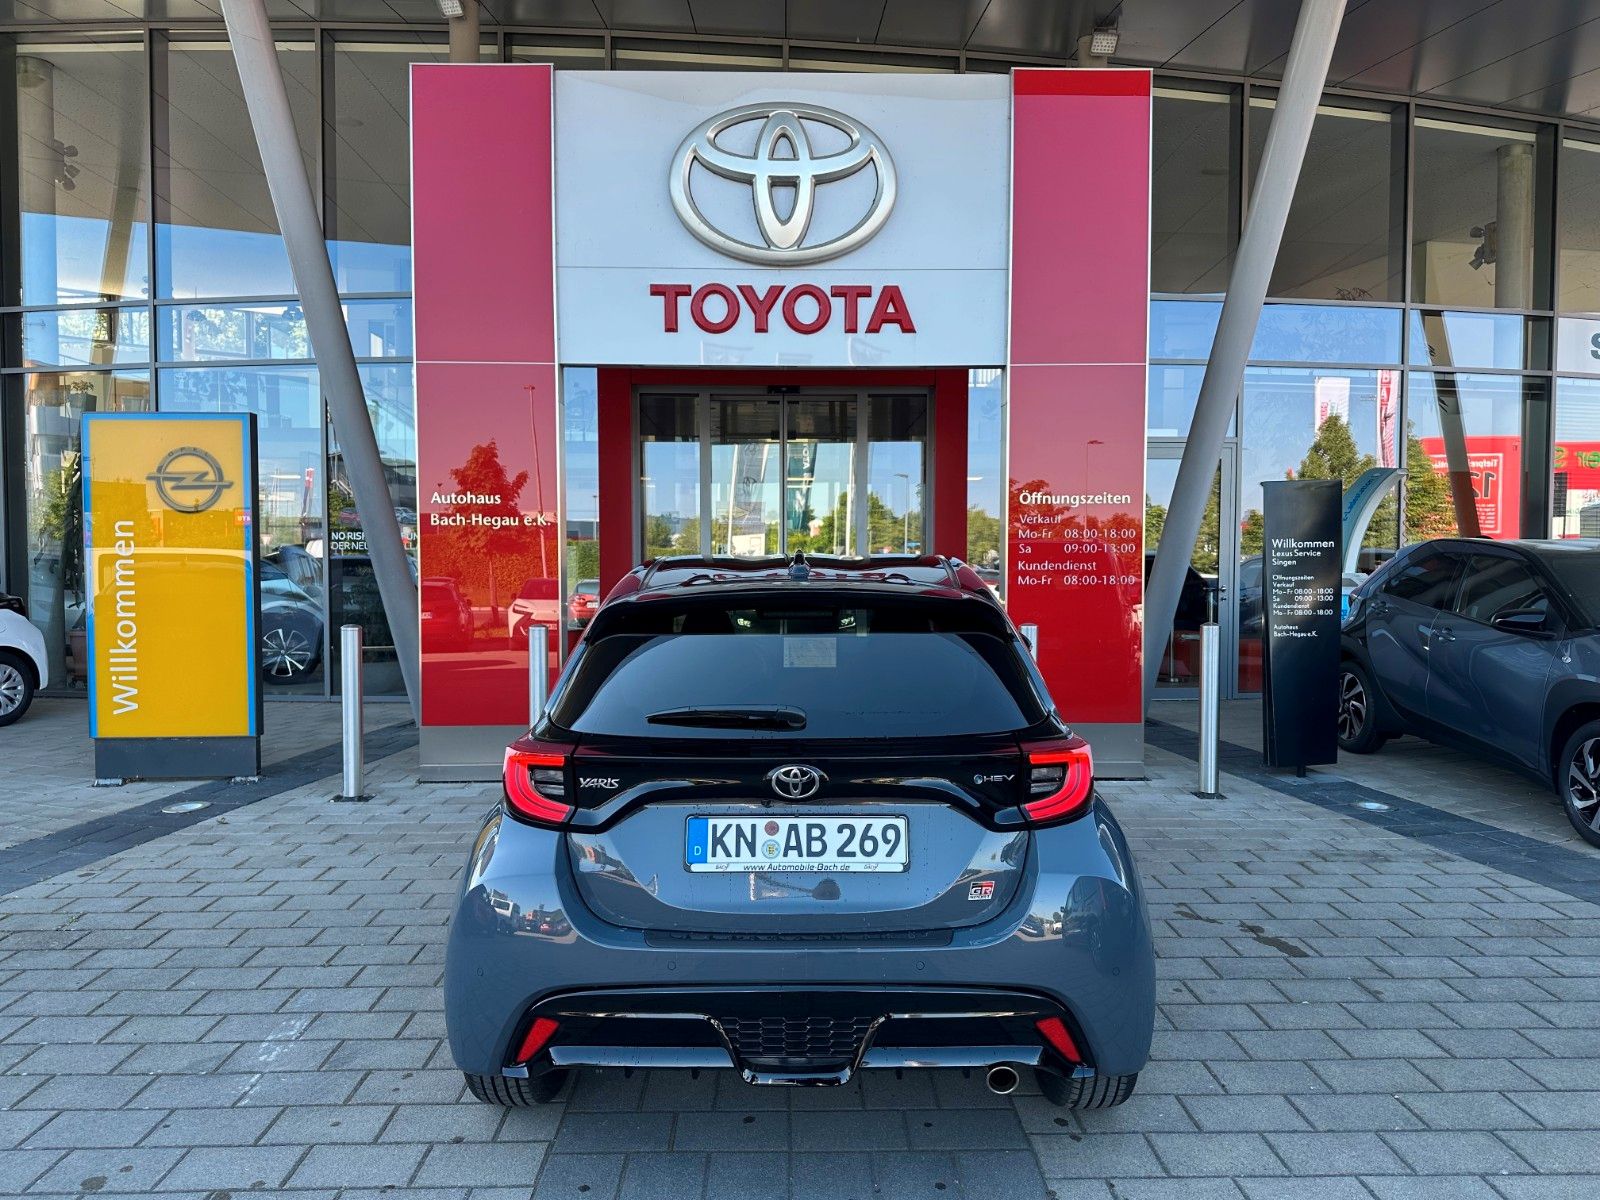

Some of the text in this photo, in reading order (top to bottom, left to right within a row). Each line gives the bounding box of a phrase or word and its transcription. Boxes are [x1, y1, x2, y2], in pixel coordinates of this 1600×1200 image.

[649, 282, 917, 335] TOYOTA
[430, 491, 502, 504] Autohaus
[1019, 490, 1131, 507] Öffnungszeiten
[430, 513, 551, 529] Bach-Hegau e.K.
[1019, 514, 1062, 524] Verkauf
[331, 531, 345, 540] NO
[1018, 529, 1136, 539] Mo-Fr 08:00-18:00
[331, 541, 350, 550] DER
[1271, 538, 1335, 548] Willkommen
[1019, 544, 1032, 554] Sa
[1272, 549, 1321, 557] Lexus Service
[1018, 560, 1097, 571] Kundendienst
[1272, 558, 1297, 567] Singen
[1017, 575, 1136, 585] Mo-Fr 08:00-18:00
[108, 520, 139, 715] Willkommen
[579, 777, 620, 789] YARIS
[983, 774, 1015, 782] HEV
[711, 823, 902, 858] KN AB 269
[693, 846, 702, 856] D
